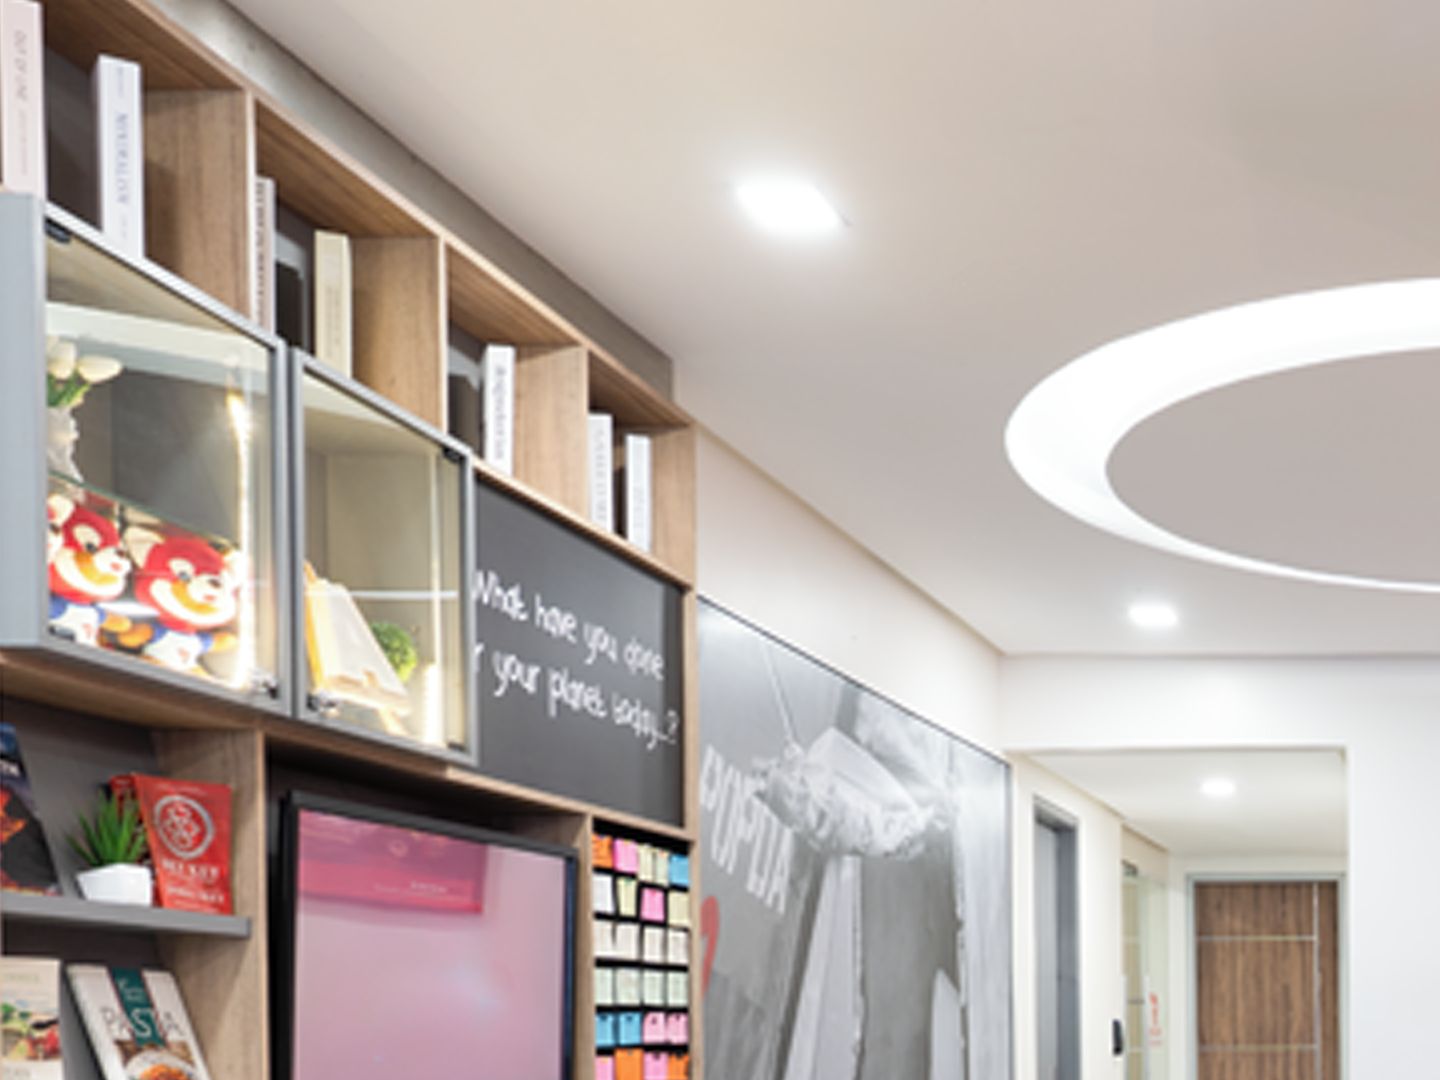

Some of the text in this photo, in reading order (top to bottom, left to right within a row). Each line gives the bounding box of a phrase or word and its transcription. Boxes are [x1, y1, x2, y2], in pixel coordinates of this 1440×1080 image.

[583, 620, 618, 665] you
[493, 650, 541, 697] your
[548, 667, 606, 718] planet
